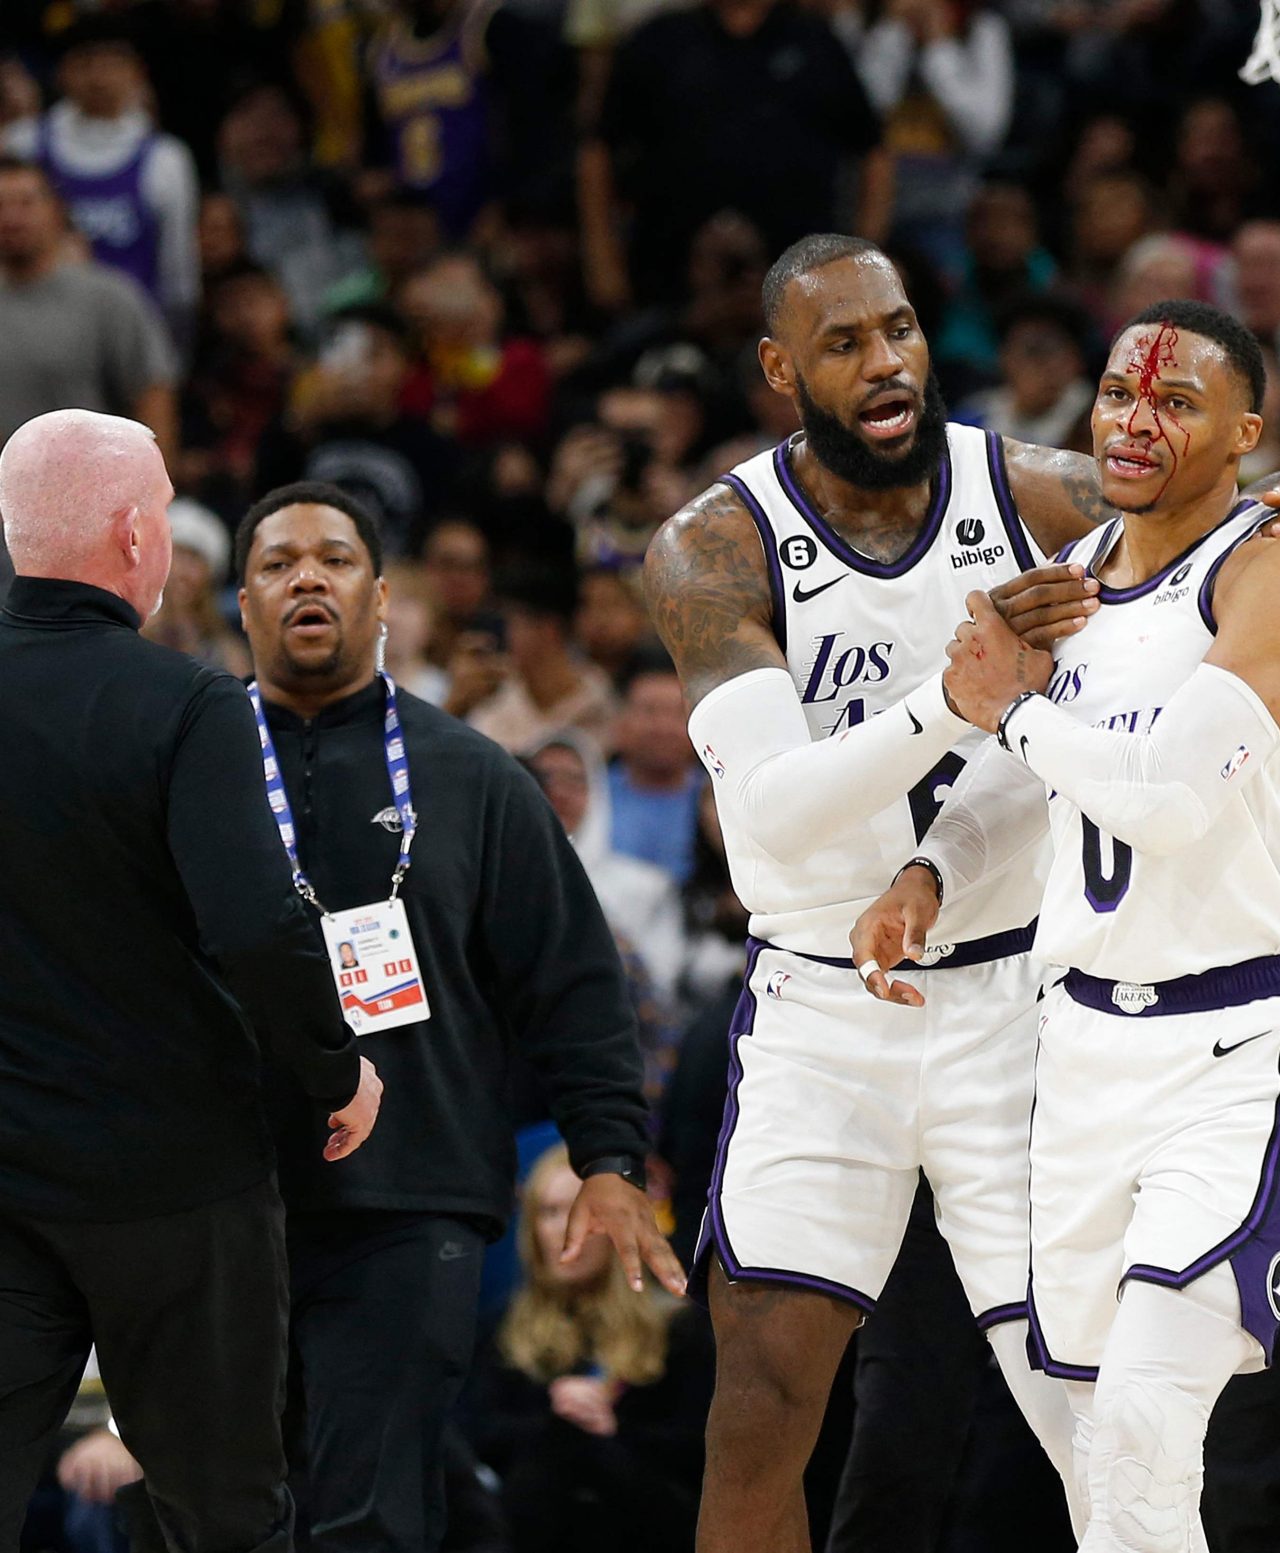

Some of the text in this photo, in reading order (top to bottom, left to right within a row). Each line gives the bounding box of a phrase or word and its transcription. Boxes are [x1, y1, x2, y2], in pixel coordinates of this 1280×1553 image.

[786, 538, 811, 567] 6
[951, 545, 1005, 570] bibigo
[1153, 586, 1190, 606] bibigo
